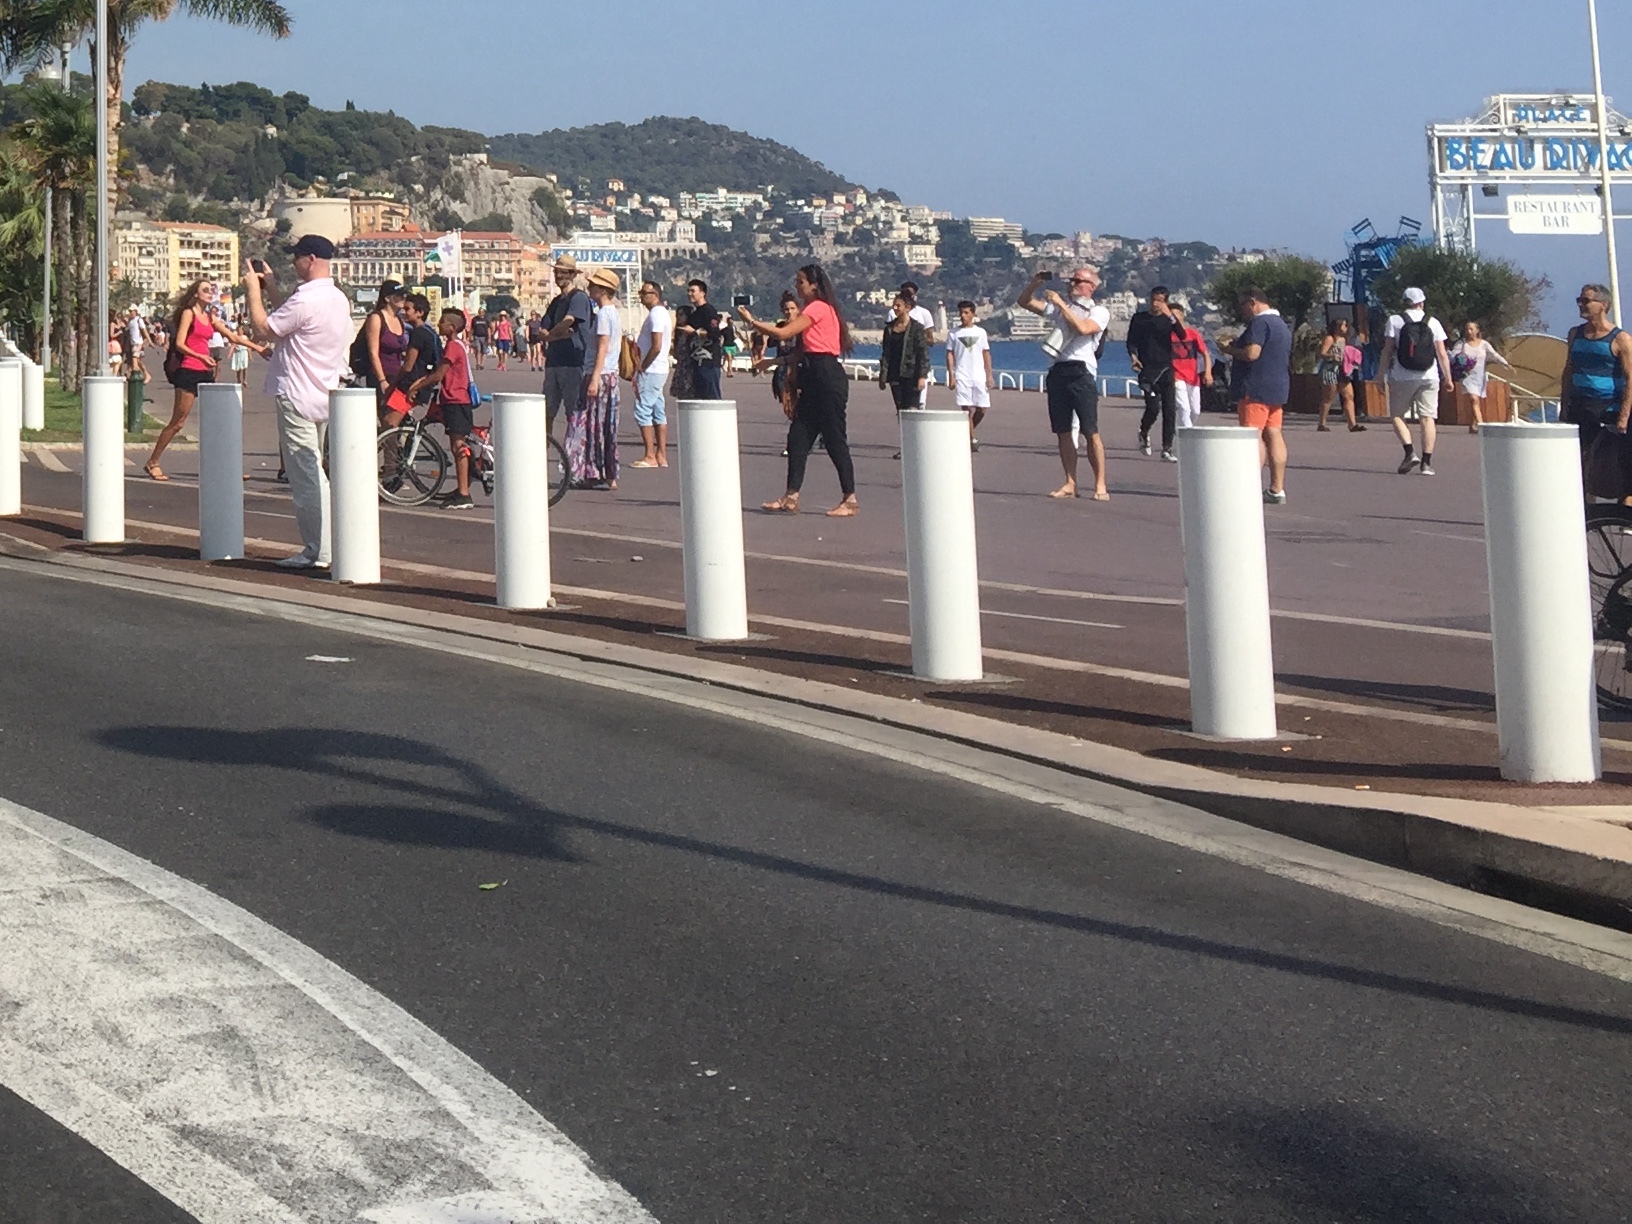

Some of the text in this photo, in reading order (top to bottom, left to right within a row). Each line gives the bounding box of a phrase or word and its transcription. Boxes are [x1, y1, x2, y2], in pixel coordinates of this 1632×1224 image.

[1446, 138, 1536, 170] BEAU
[1514, 201, 1597, 214] RESTAURANT
[1543, 215, 1570, 228] BAR
